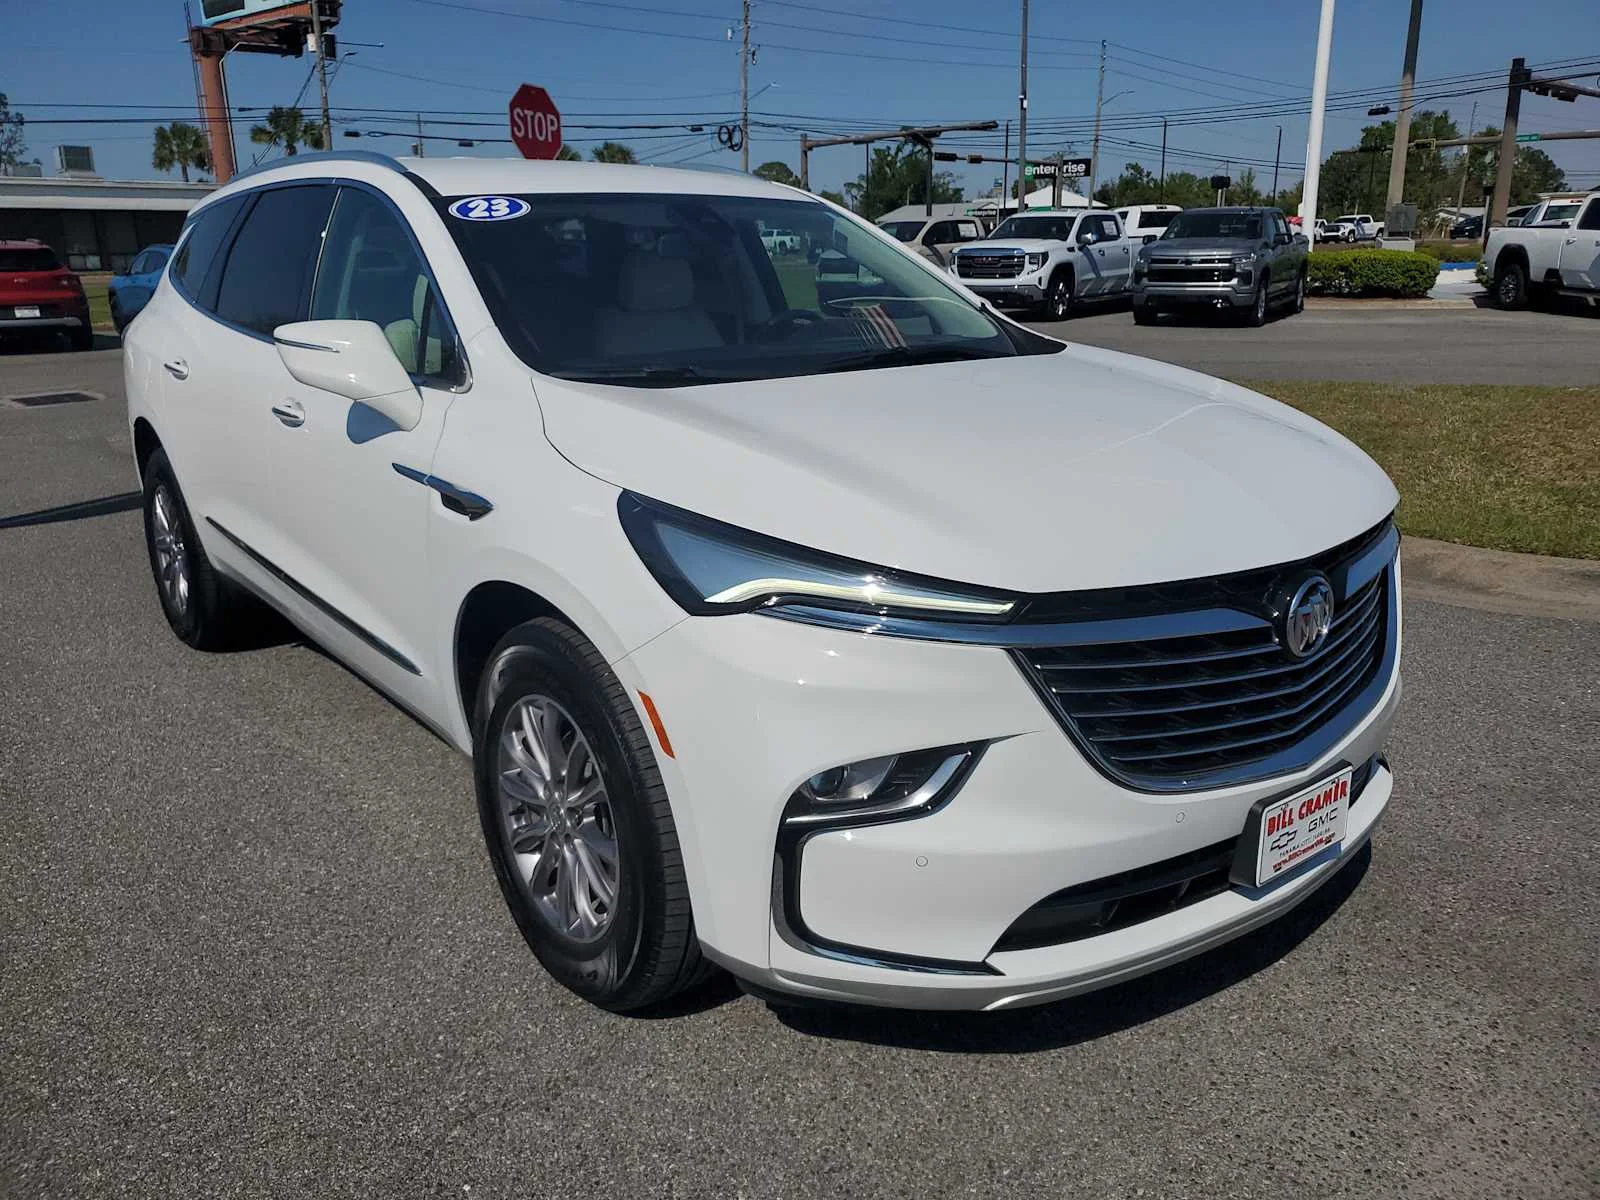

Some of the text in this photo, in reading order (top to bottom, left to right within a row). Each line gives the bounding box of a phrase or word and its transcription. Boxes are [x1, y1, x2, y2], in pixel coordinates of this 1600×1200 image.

[513, 107, 558, 142] STOP
[467, 198, 510, 218] 23
[1267, 807, 1294, 837] BILL
[1308, 807, 1338, 832] GMC
